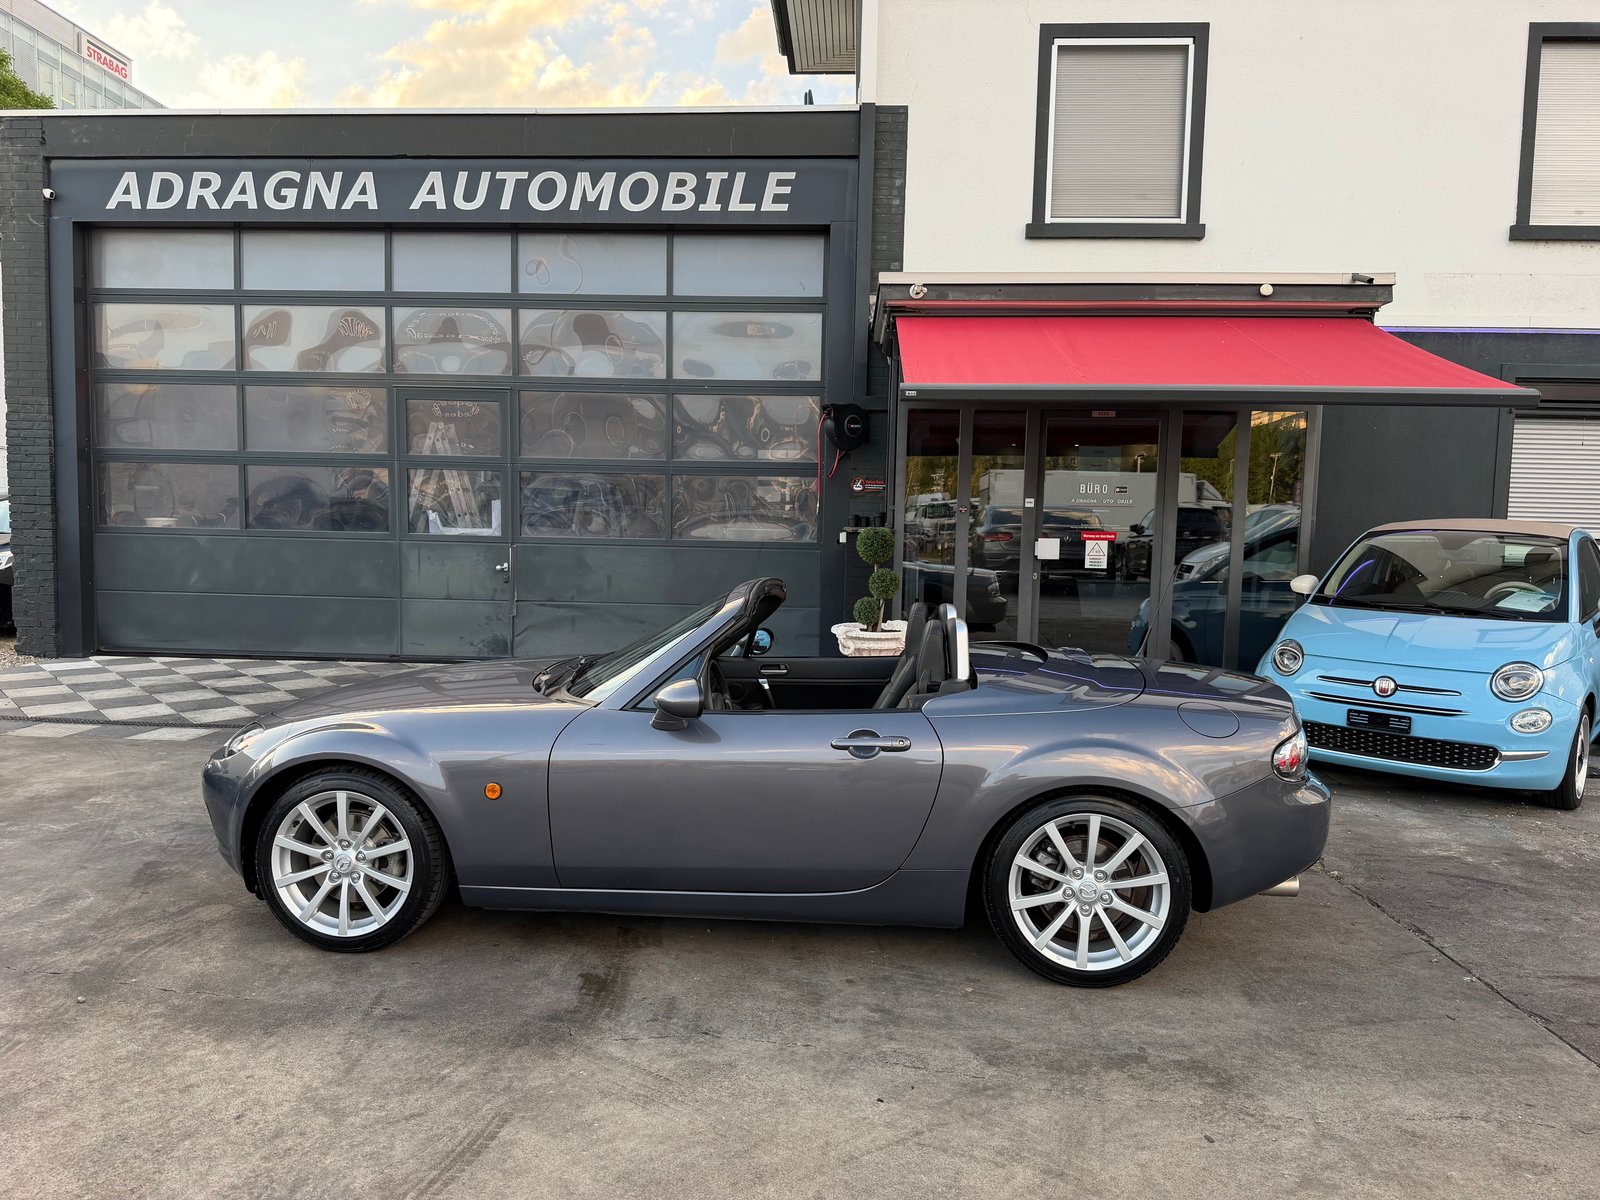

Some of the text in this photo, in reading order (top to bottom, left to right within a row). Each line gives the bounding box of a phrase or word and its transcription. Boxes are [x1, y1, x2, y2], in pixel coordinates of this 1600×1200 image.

[87, 45, 128, 79] STRABAG
[105, 170, 797, 212] ADRAGNA AUTOMOBILE
[1080, 483, 1108, 494] BÜRO
